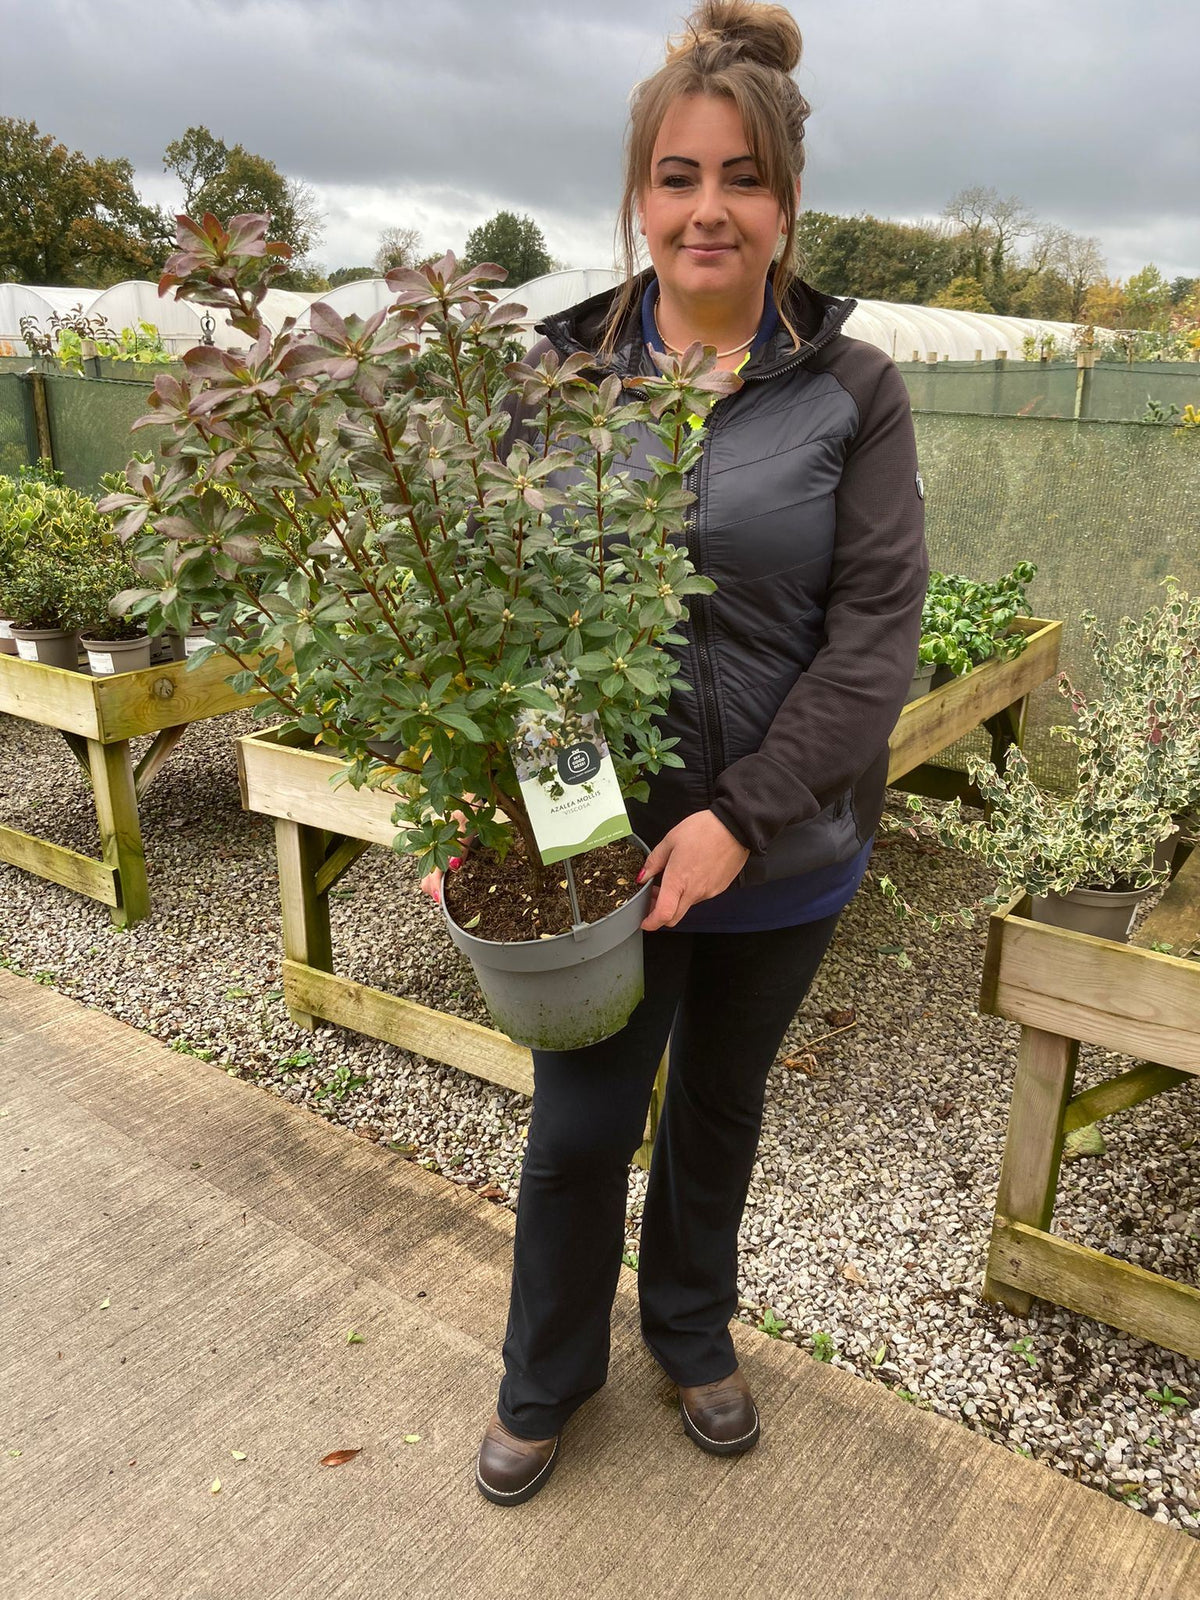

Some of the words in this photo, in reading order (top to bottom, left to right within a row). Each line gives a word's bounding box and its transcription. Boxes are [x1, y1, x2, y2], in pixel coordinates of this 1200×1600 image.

[551, 801, 576, 814] AZALEA
[577, 790, 601, 803] MOLLIS
[564, 802, 591, 815] VISCOSA
